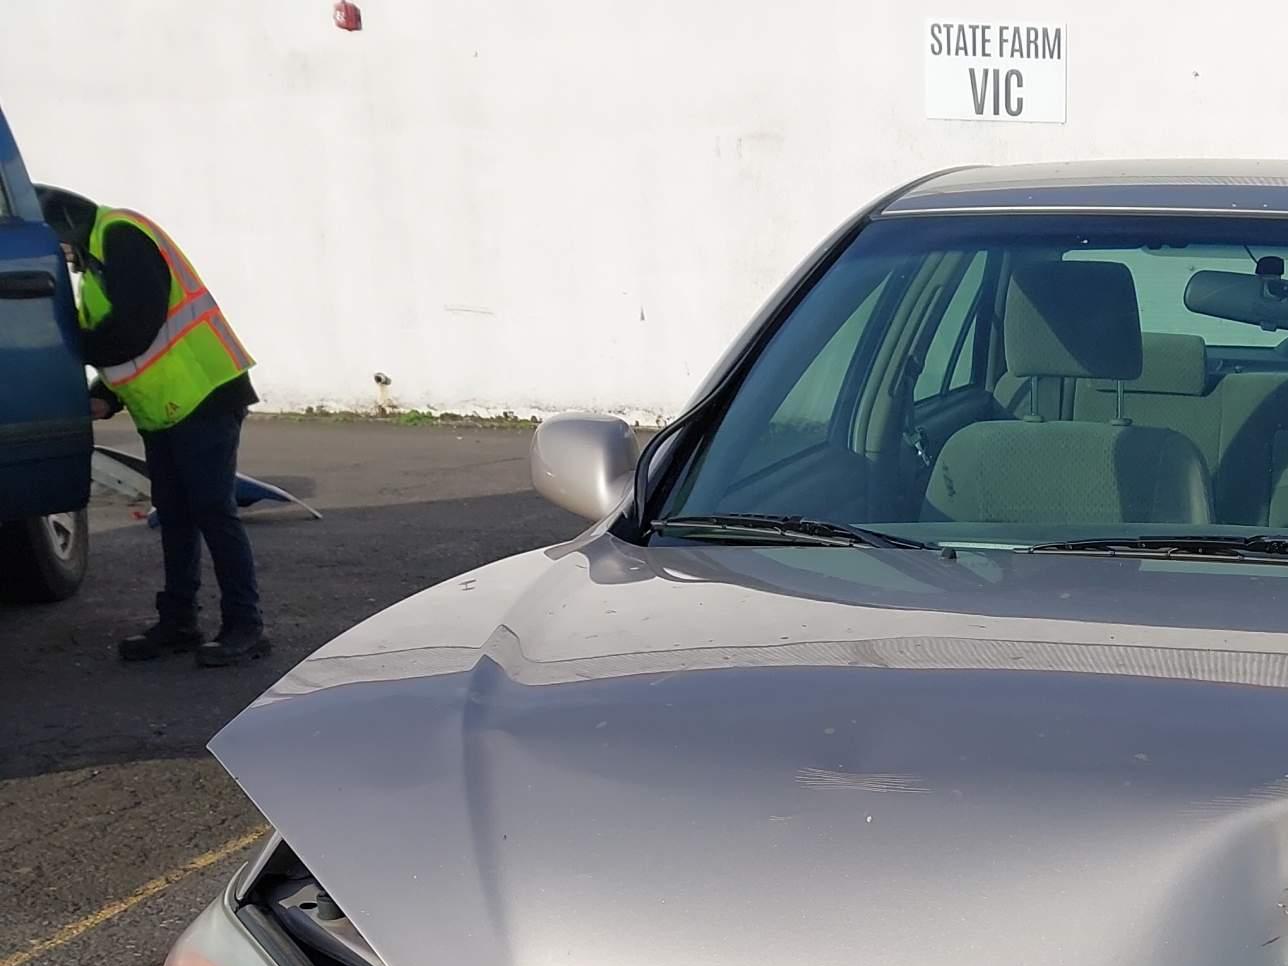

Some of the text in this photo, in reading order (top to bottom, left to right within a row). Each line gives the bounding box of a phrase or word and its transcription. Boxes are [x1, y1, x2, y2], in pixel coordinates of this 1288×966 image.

[930, 23, 1062, 60] STATE FARM
[968, 67, 1024, 117] VIC
